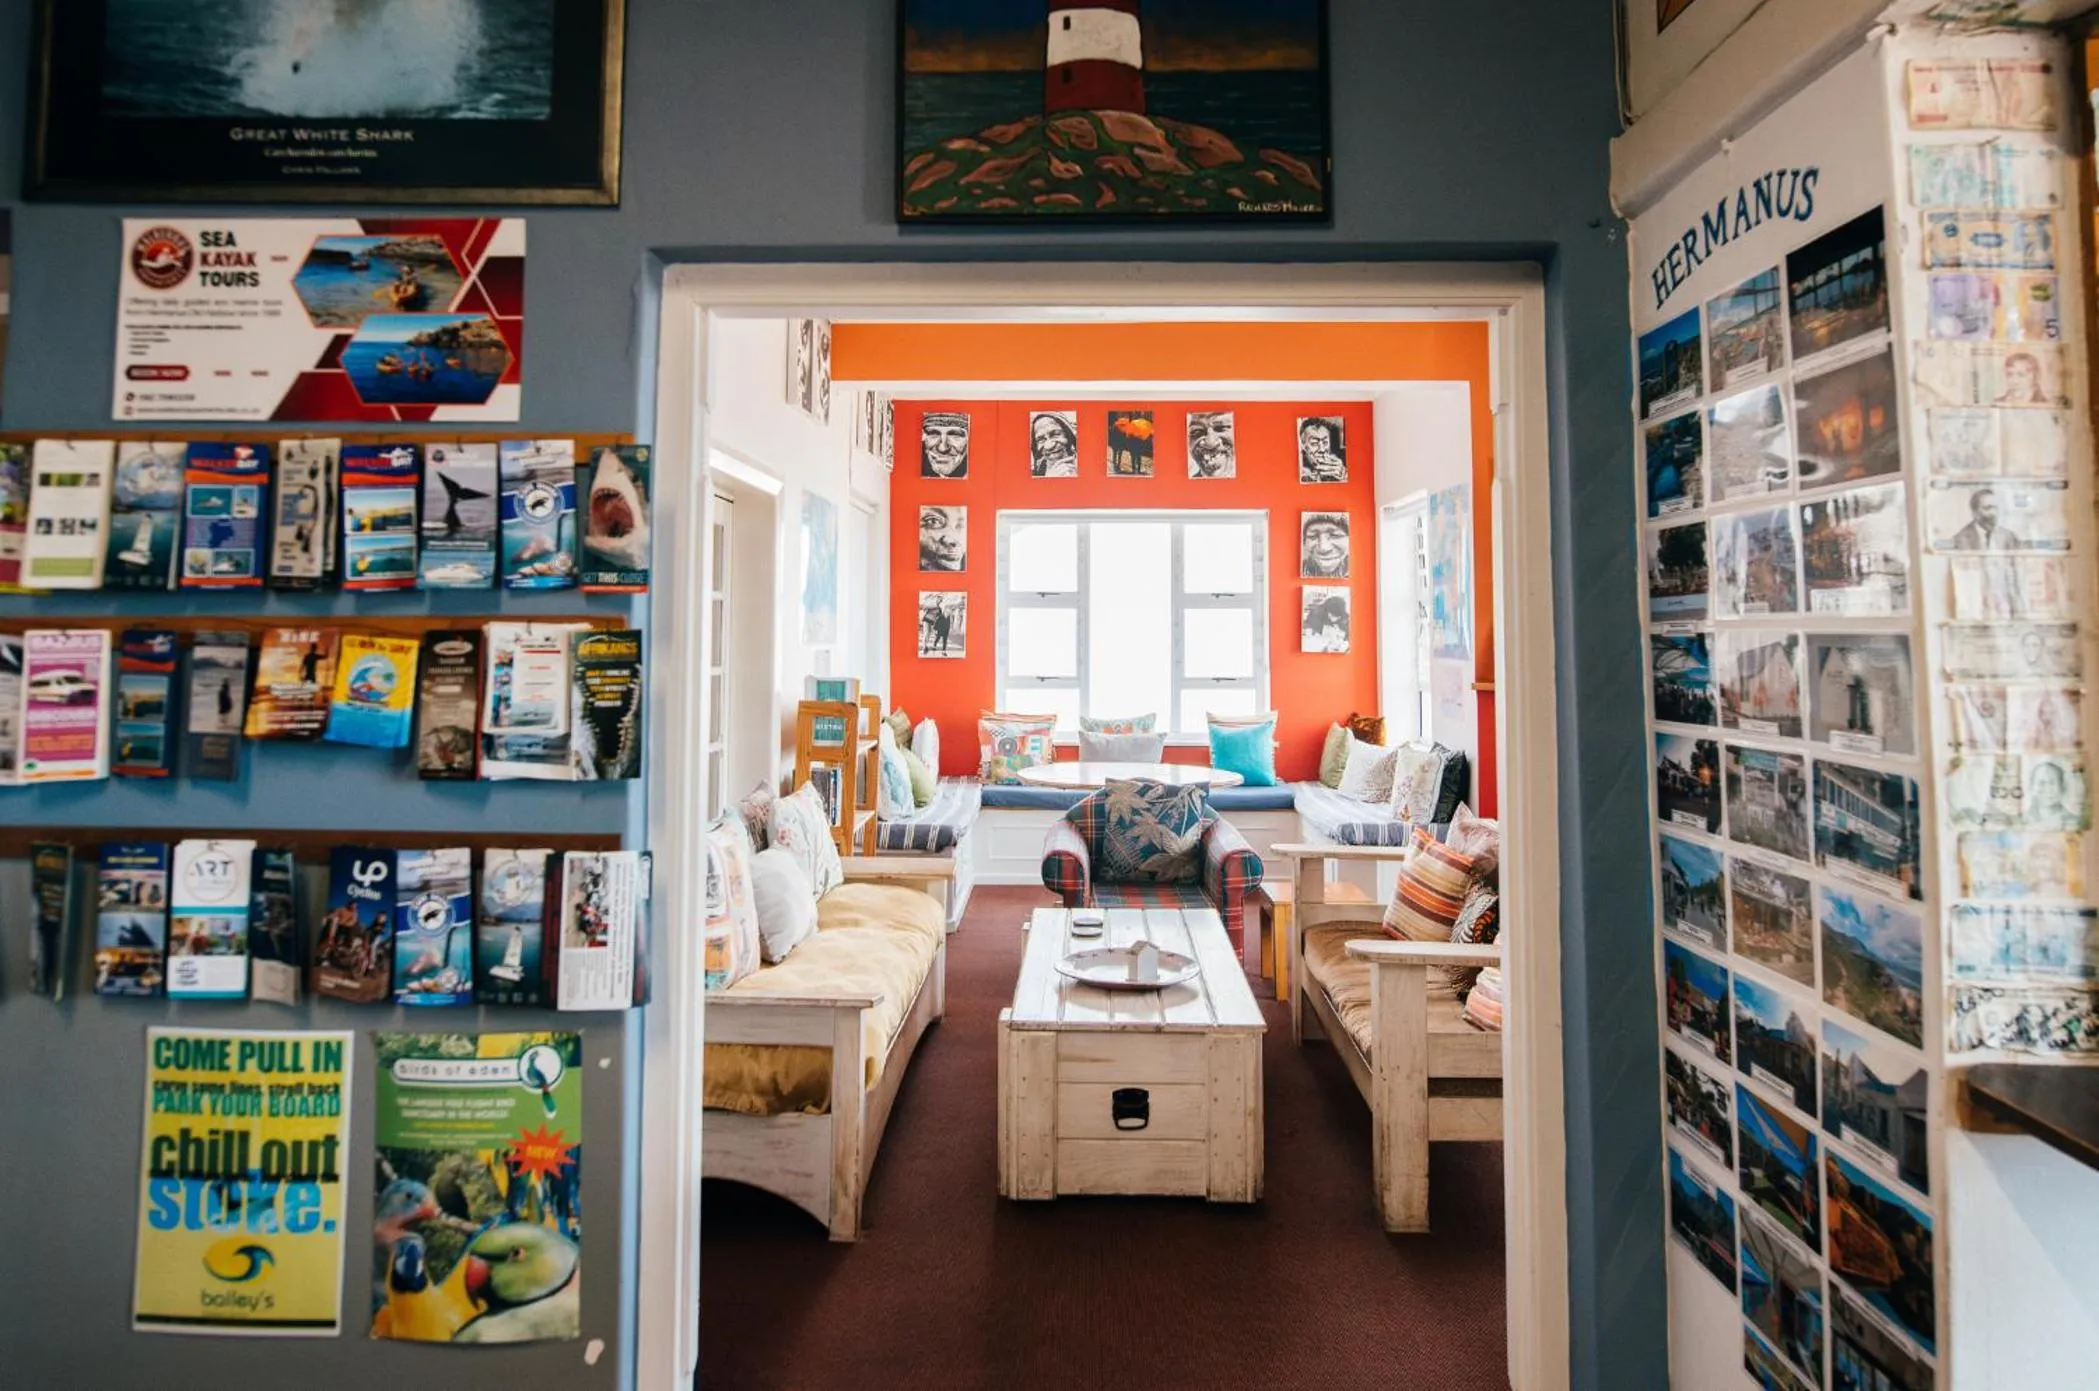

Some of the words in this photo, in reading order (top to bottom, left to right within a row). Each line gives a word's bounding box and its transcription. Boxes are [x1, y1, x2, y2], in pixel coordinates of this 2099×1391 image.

[229, 127, 288, 141] GREAT
[292, 127, 350, 141] WHITE
[355, 127, 415, 141] SHARK
[200, 230, 237, 248] SEA
[1652, 165, 1819, 310] HERMANUS
[200, 251, 257, 268] KAYAK
[200, 271, 260, 288] TOURS
[2045, 318, 2060, 339] 5
[153, 1036, 231, 1071] COME
[238, 1040, 304, 1073] PULL
[312, 1041, 342, 1073] IN
[400, 1064, 437, 1075] birds
[445, 1064, 460, 1075] of
[469, 1064, 511, 1075] eden
[209, 1089, 262, 1117] YOUR
[268, 1090, 341, 1118] BOARD
[151, 1128, 250, 1181] chill
[261, 1134, 340, 1182] out
[148, 1168, 337, 1234] stoke.
[201, 1289, 275, 1312] bailey's
